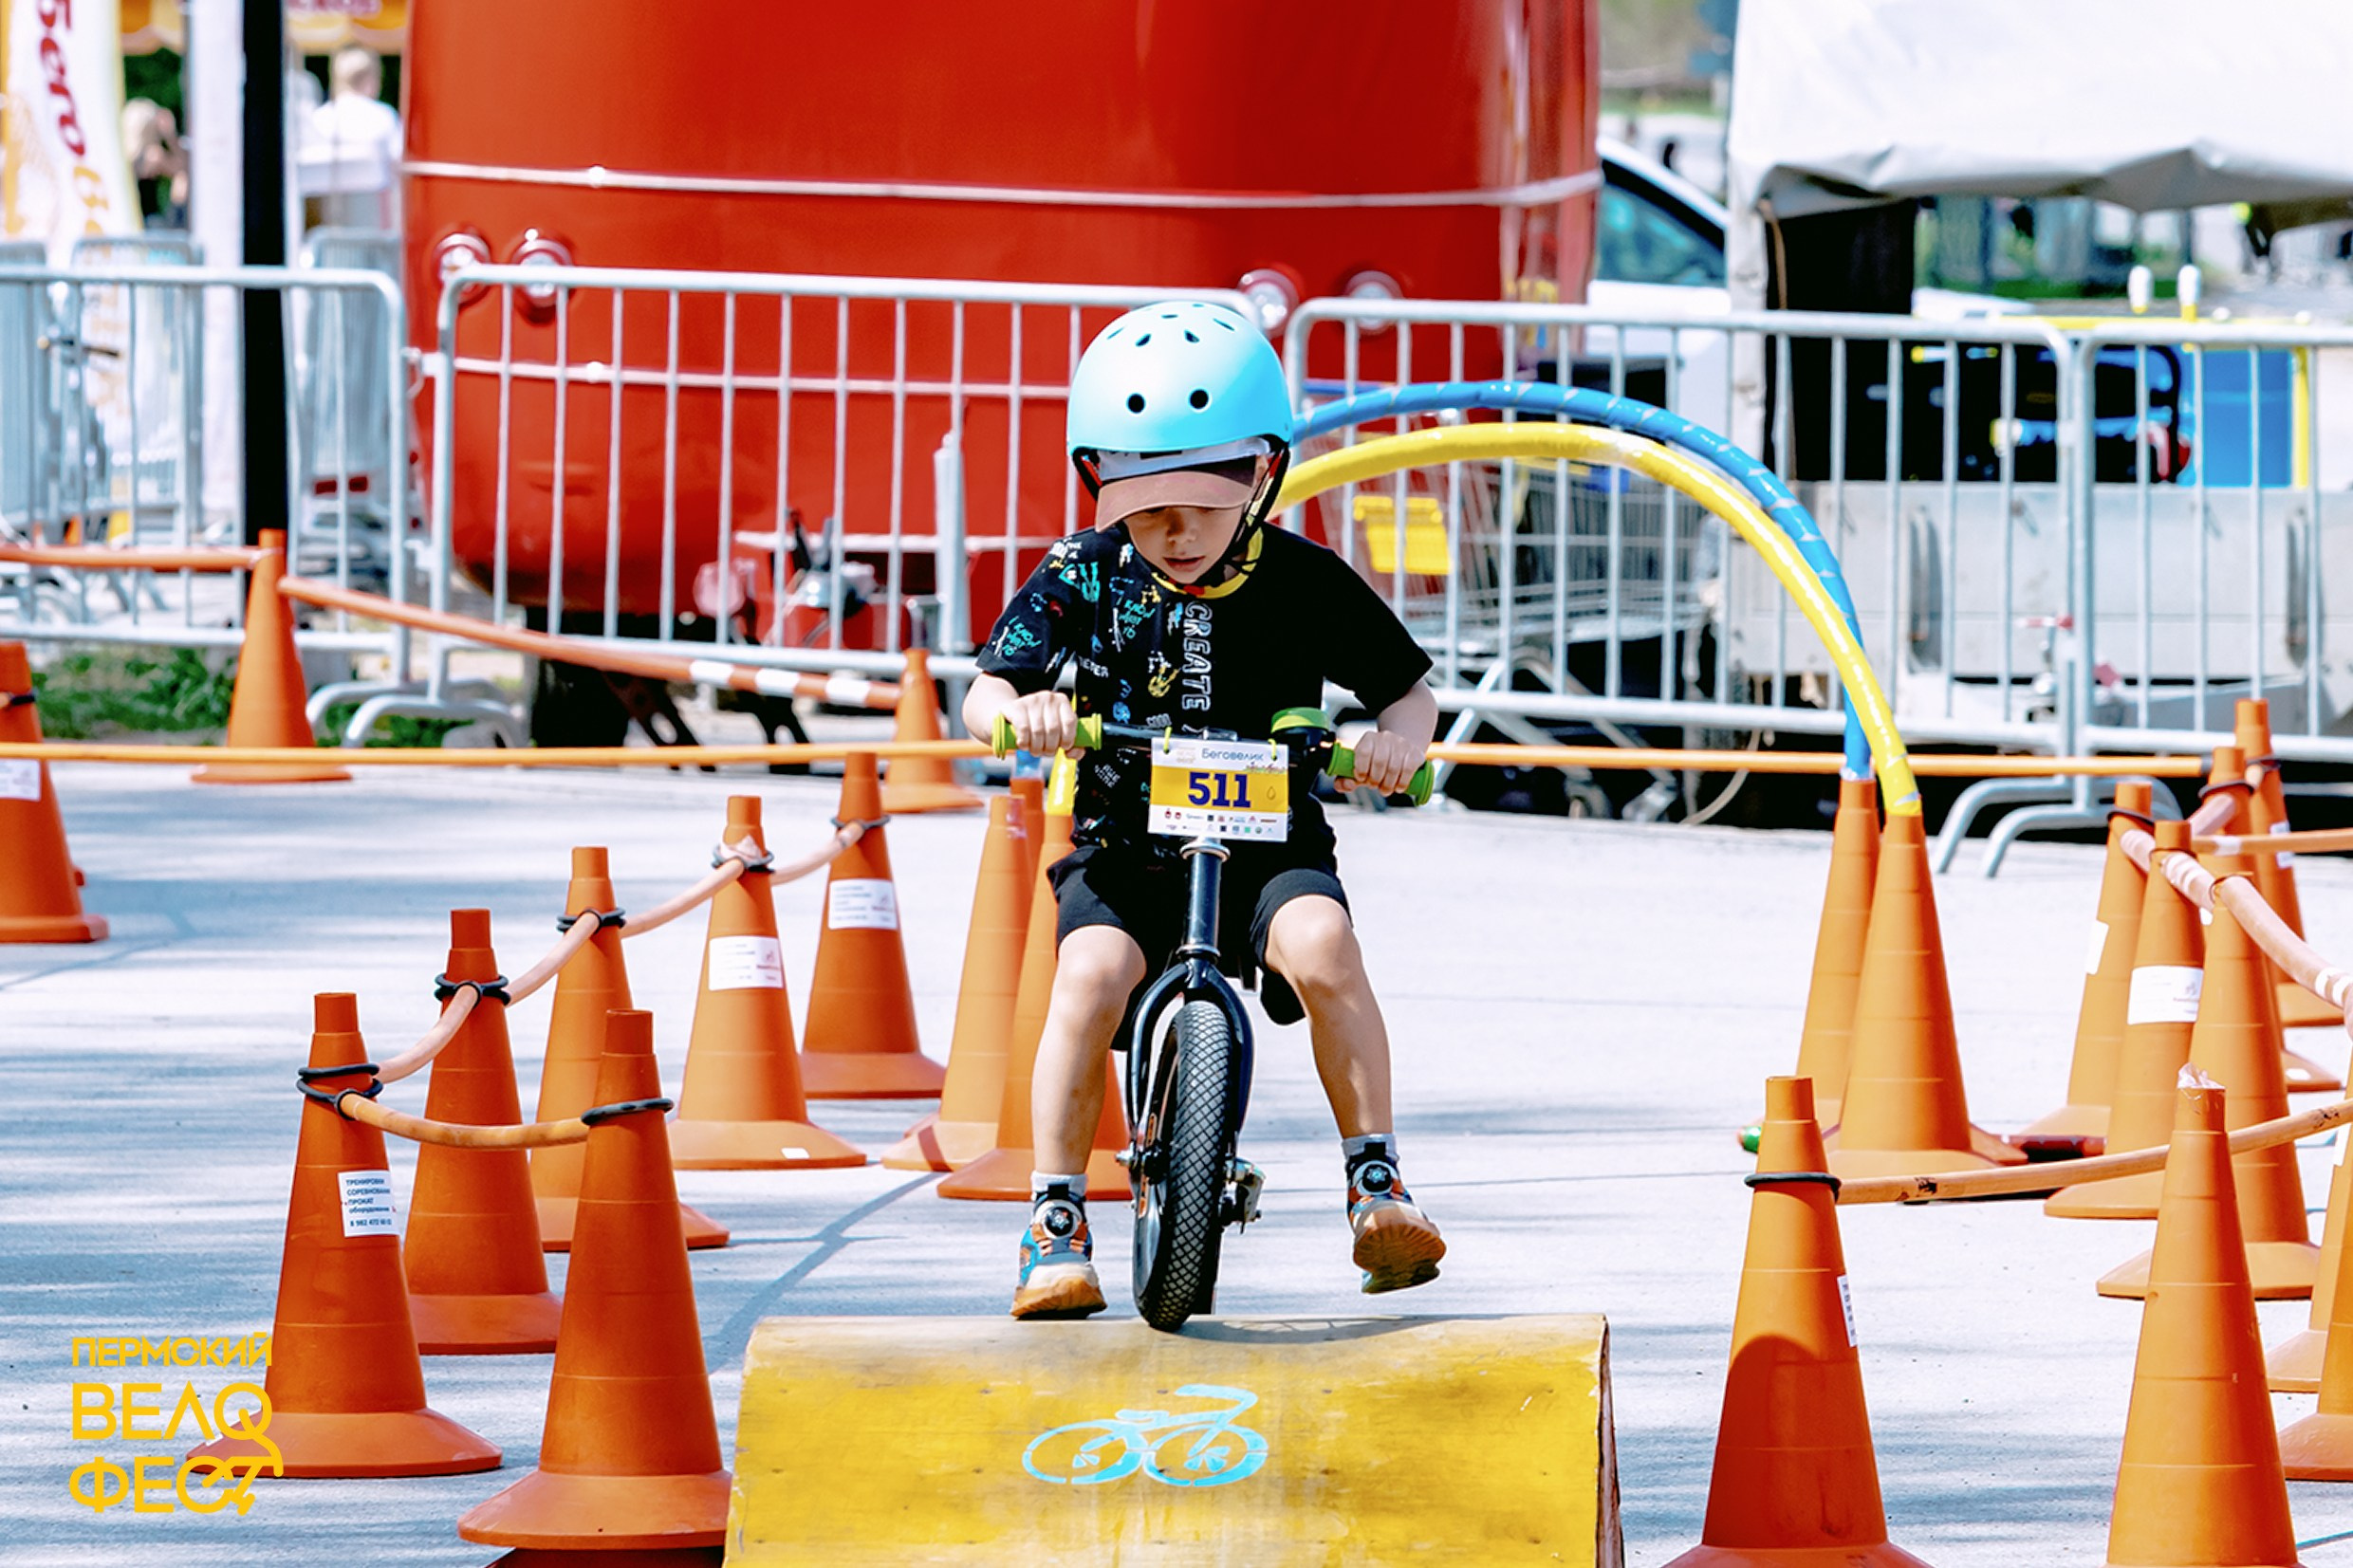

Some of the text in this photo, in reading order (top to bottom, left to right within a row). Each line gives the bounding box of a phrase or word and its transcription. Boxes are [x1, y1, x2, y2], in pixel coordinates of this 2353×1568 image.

[1181, 600, 1213, 711] CREATE
[1201, 747, 1264, 761] Беговелик
[1188, 771, 1251, 808] 511
